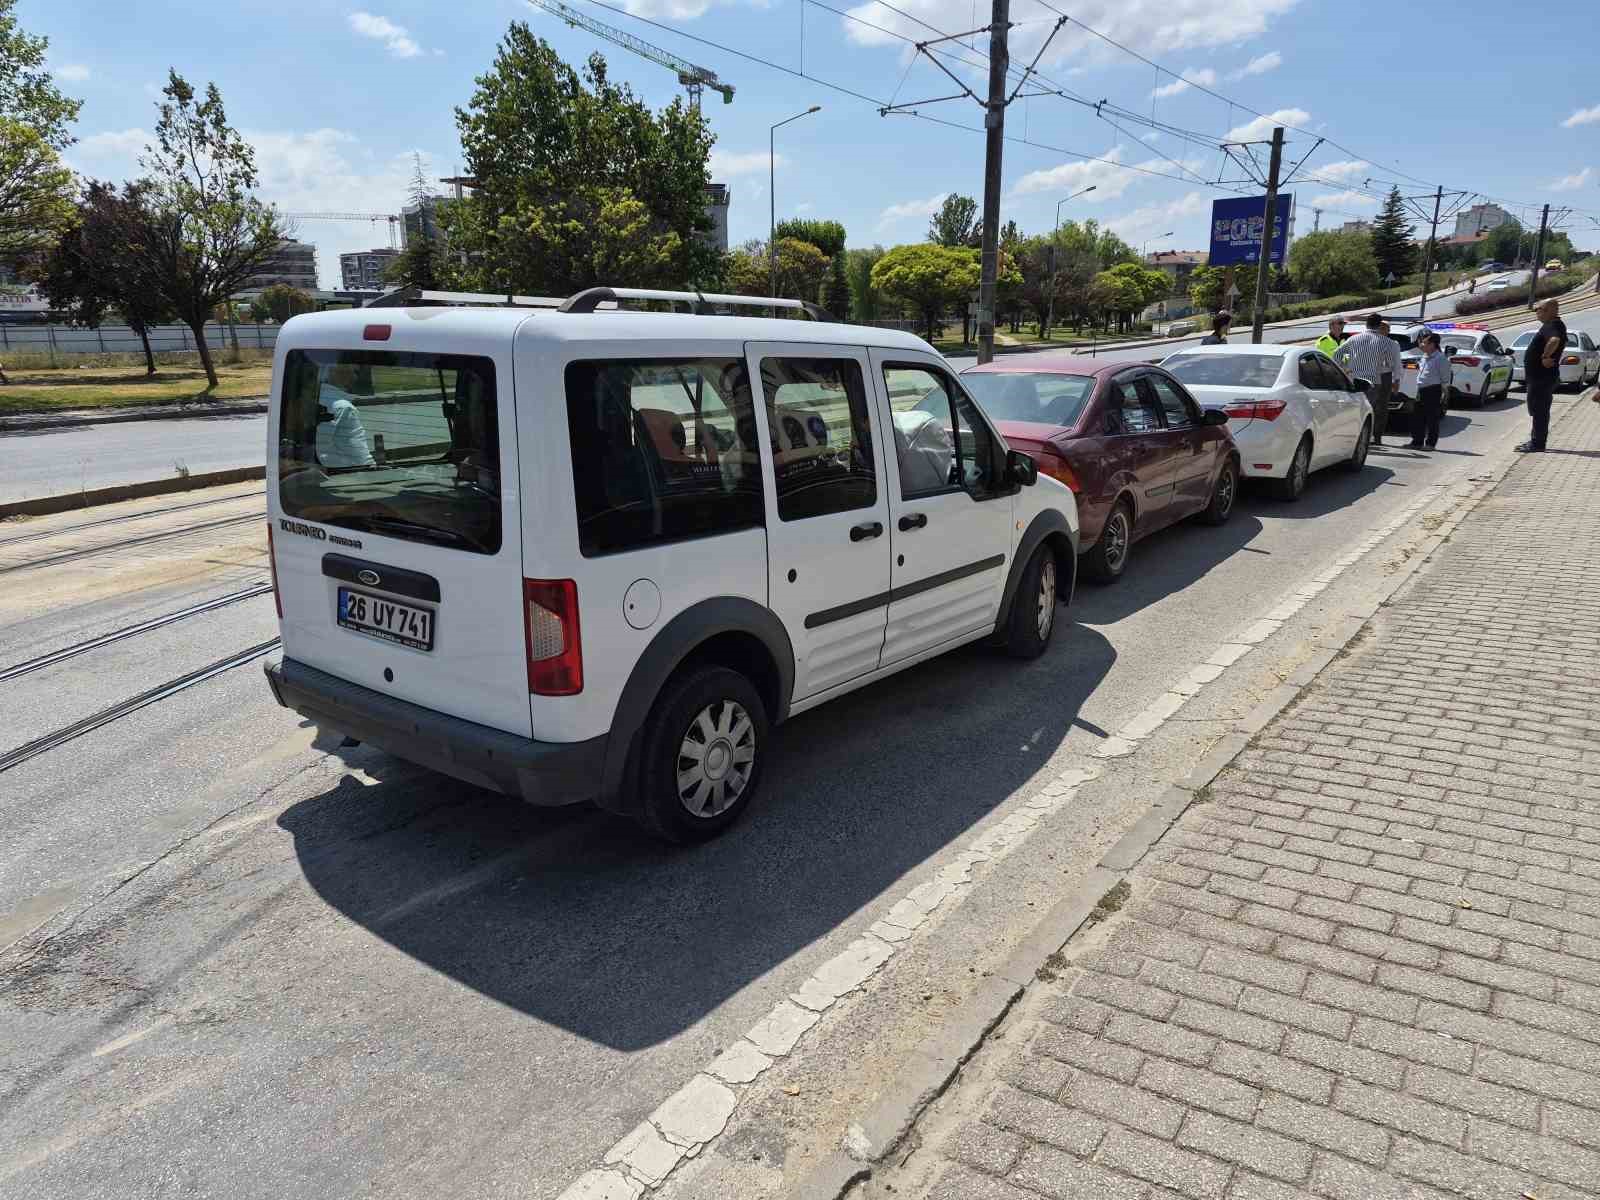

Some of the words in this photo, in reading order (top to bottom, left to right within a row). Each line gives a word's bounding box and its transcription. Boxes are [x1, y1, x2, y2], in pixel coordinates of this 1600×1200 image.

[279, 519, 326, 540] TOURNEO
[348, 595, 367, 620] 26
[374, 601, 395, 629] UY
[399, 608, 427, 639] 741
